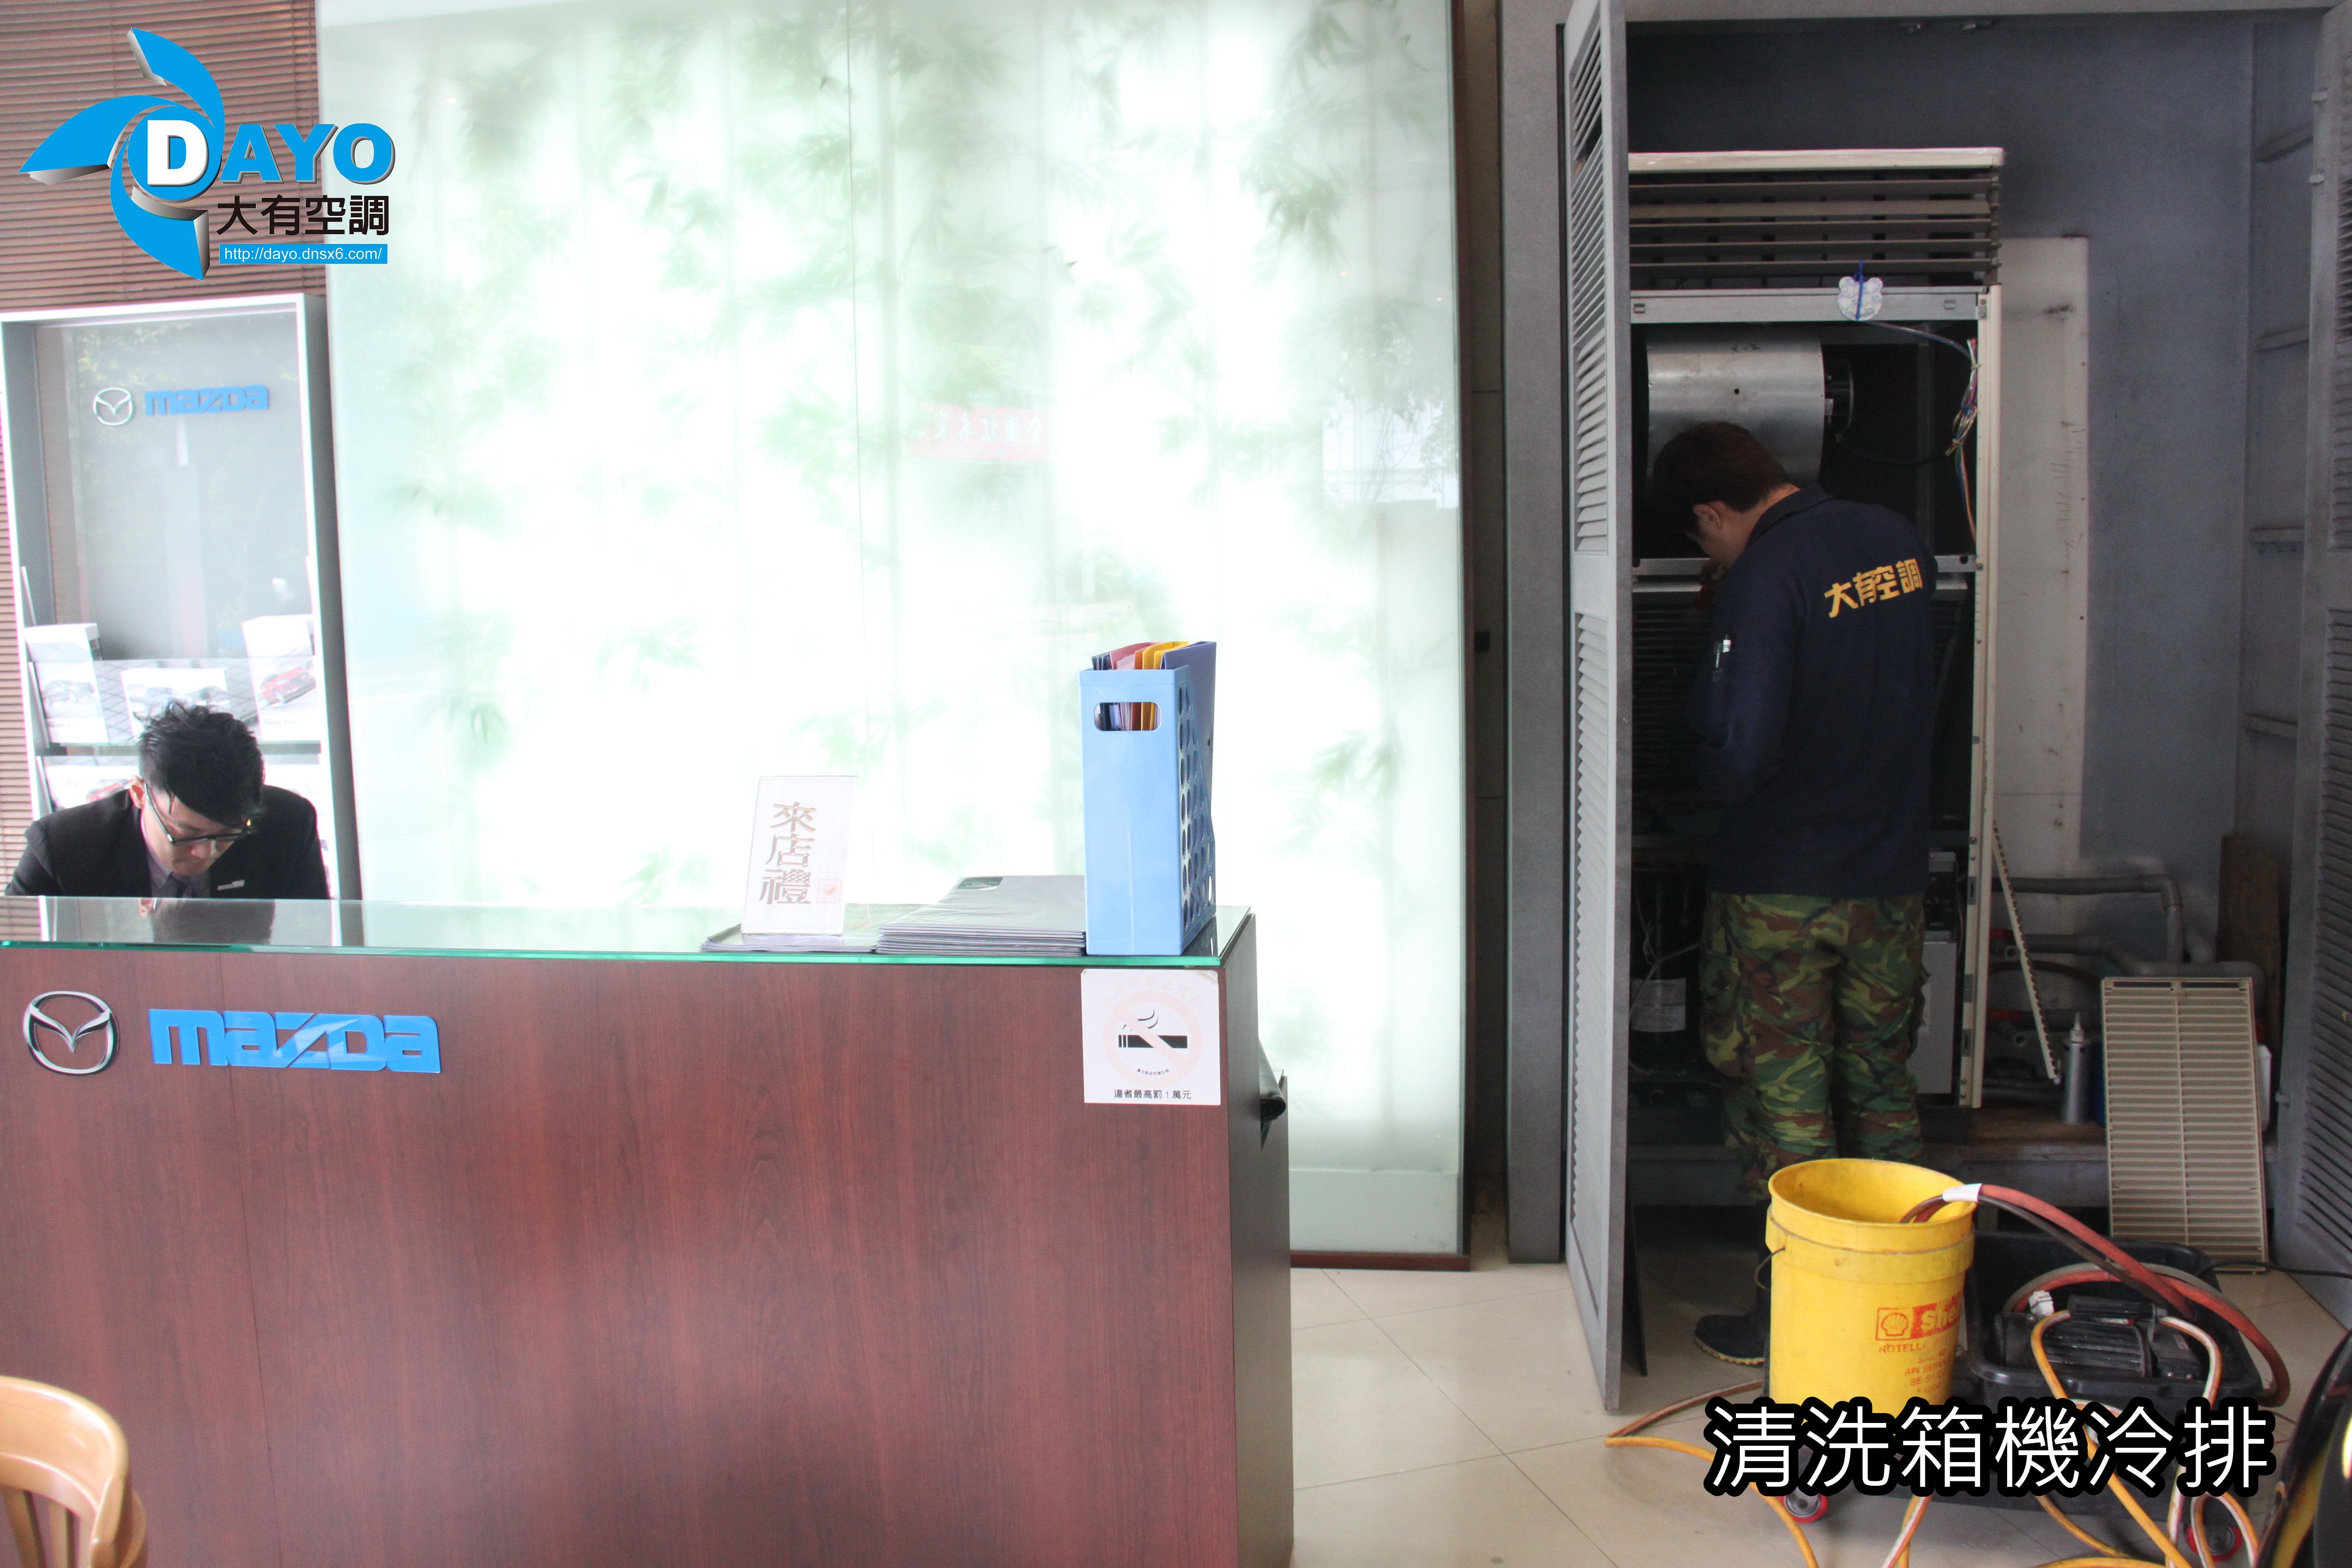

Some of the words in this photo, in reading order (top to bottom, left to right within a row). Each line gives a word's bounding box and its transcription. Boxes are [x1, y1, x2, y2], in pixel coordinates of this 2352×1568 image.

[1823, 558, 1924, 619] 大有空調
[758, 801, 818, 905] 來店禮
[148, 1008, 442, 1074] mazda
